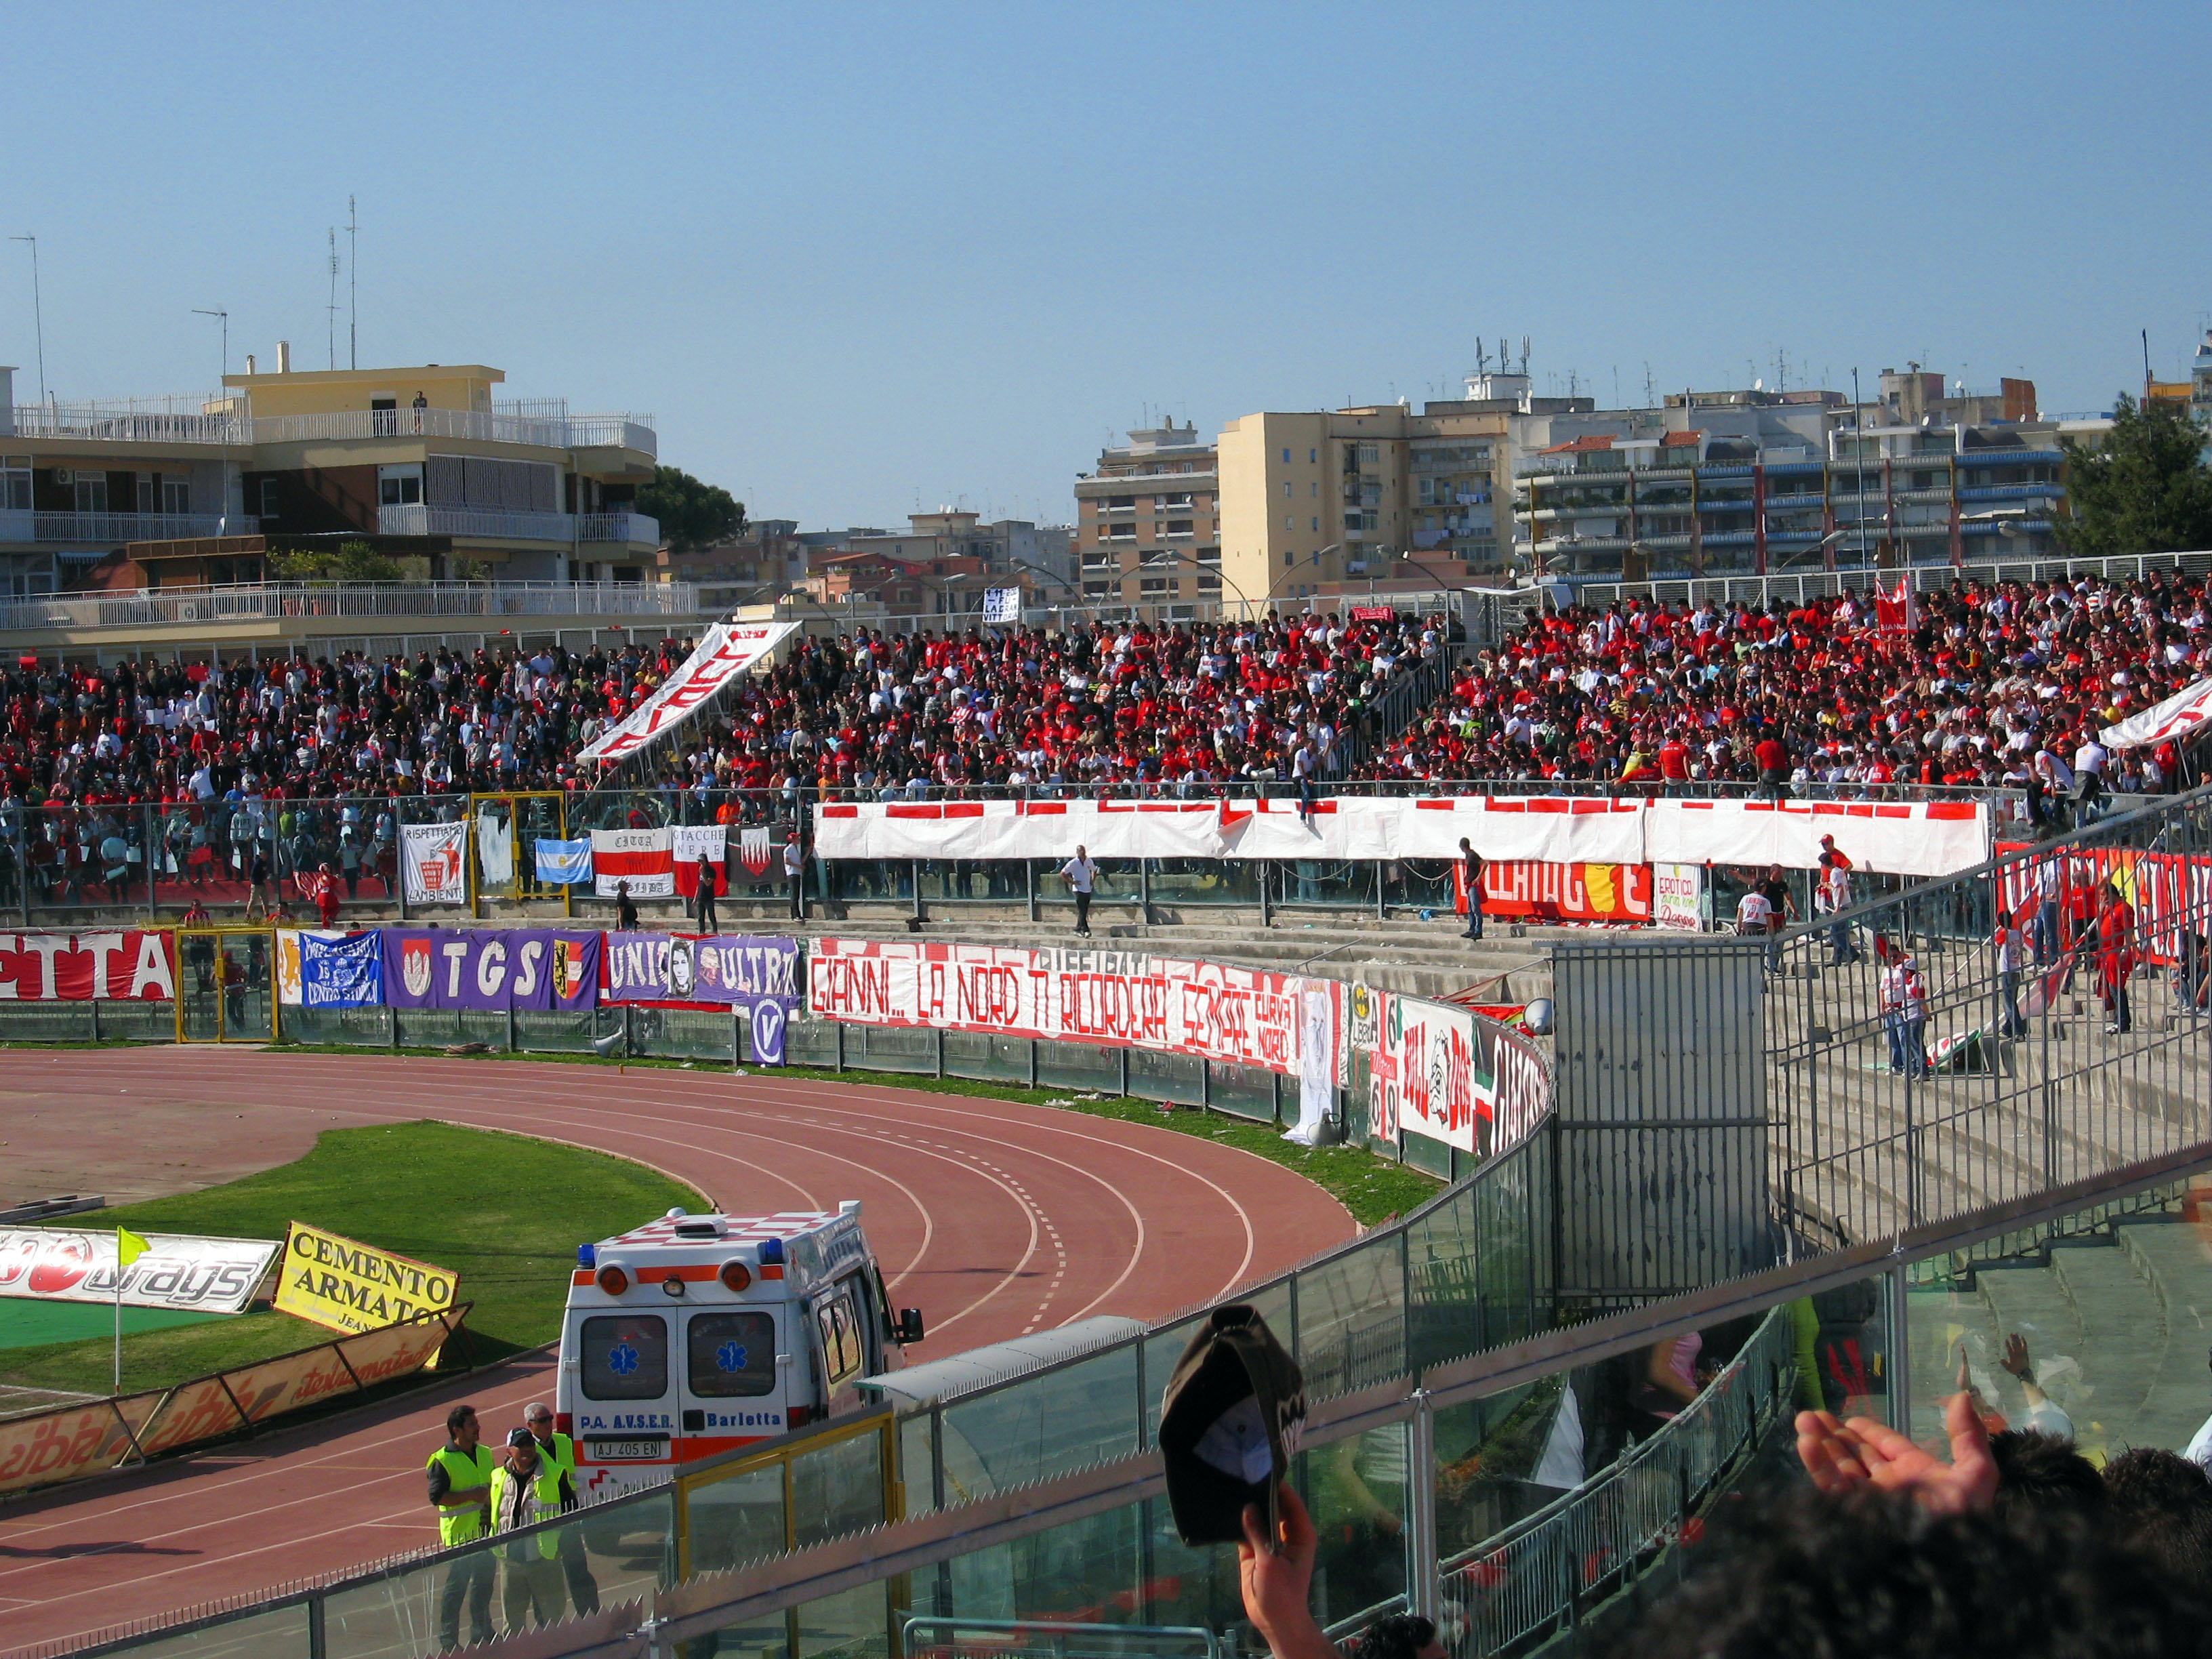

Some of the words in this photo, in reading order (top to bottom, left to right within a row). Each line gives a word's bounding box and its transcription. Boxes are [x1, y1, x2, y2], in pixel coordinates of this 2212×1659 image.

[985, 605, 997, 613] LA
[406, 824, 464, 840] RISPETTIAMO
[673, 830, 724, 842] GIACCHE
[408, 887, 464, 901] L'AMBIENTE
[611, 882, 664, 894] DSFIDA
[1659, 877, 1692, 895] EROTICO
[443, 940, 542, 998] TGS
[1040, 947, 1149, 977] DIFFIDATI
[917, 963, 945, 1018] LA
[957, 964, 1019, 1025] NORD
[1028, 970, 1049, 1029] TI
[1182, 982, 1252, 1057] SEMPRE
[1255, 994, 1291, 1030] CURVA
[1389, 1000, 1396, 1051] 6
[1258, 1026, 1289, 1063] NORD
[1372, 1080, 1380, 1126] 6
[1388, 1084, 1396, 1135] 9
[293, 1231, 449, 1305] CEMENTO
[293, 1267, 434, 1327] ARMATO
[580, 1416, 607, 1429] P.A.
[613, 1414, 674, 1429] A.V.S.E.R.
[706, 1412, 781, 1427] Barletta
[597, 1442, 613, 1456] AJ
[618, 1442, 639, 1455] 405
[643, 1441, 658, 1455] EN
